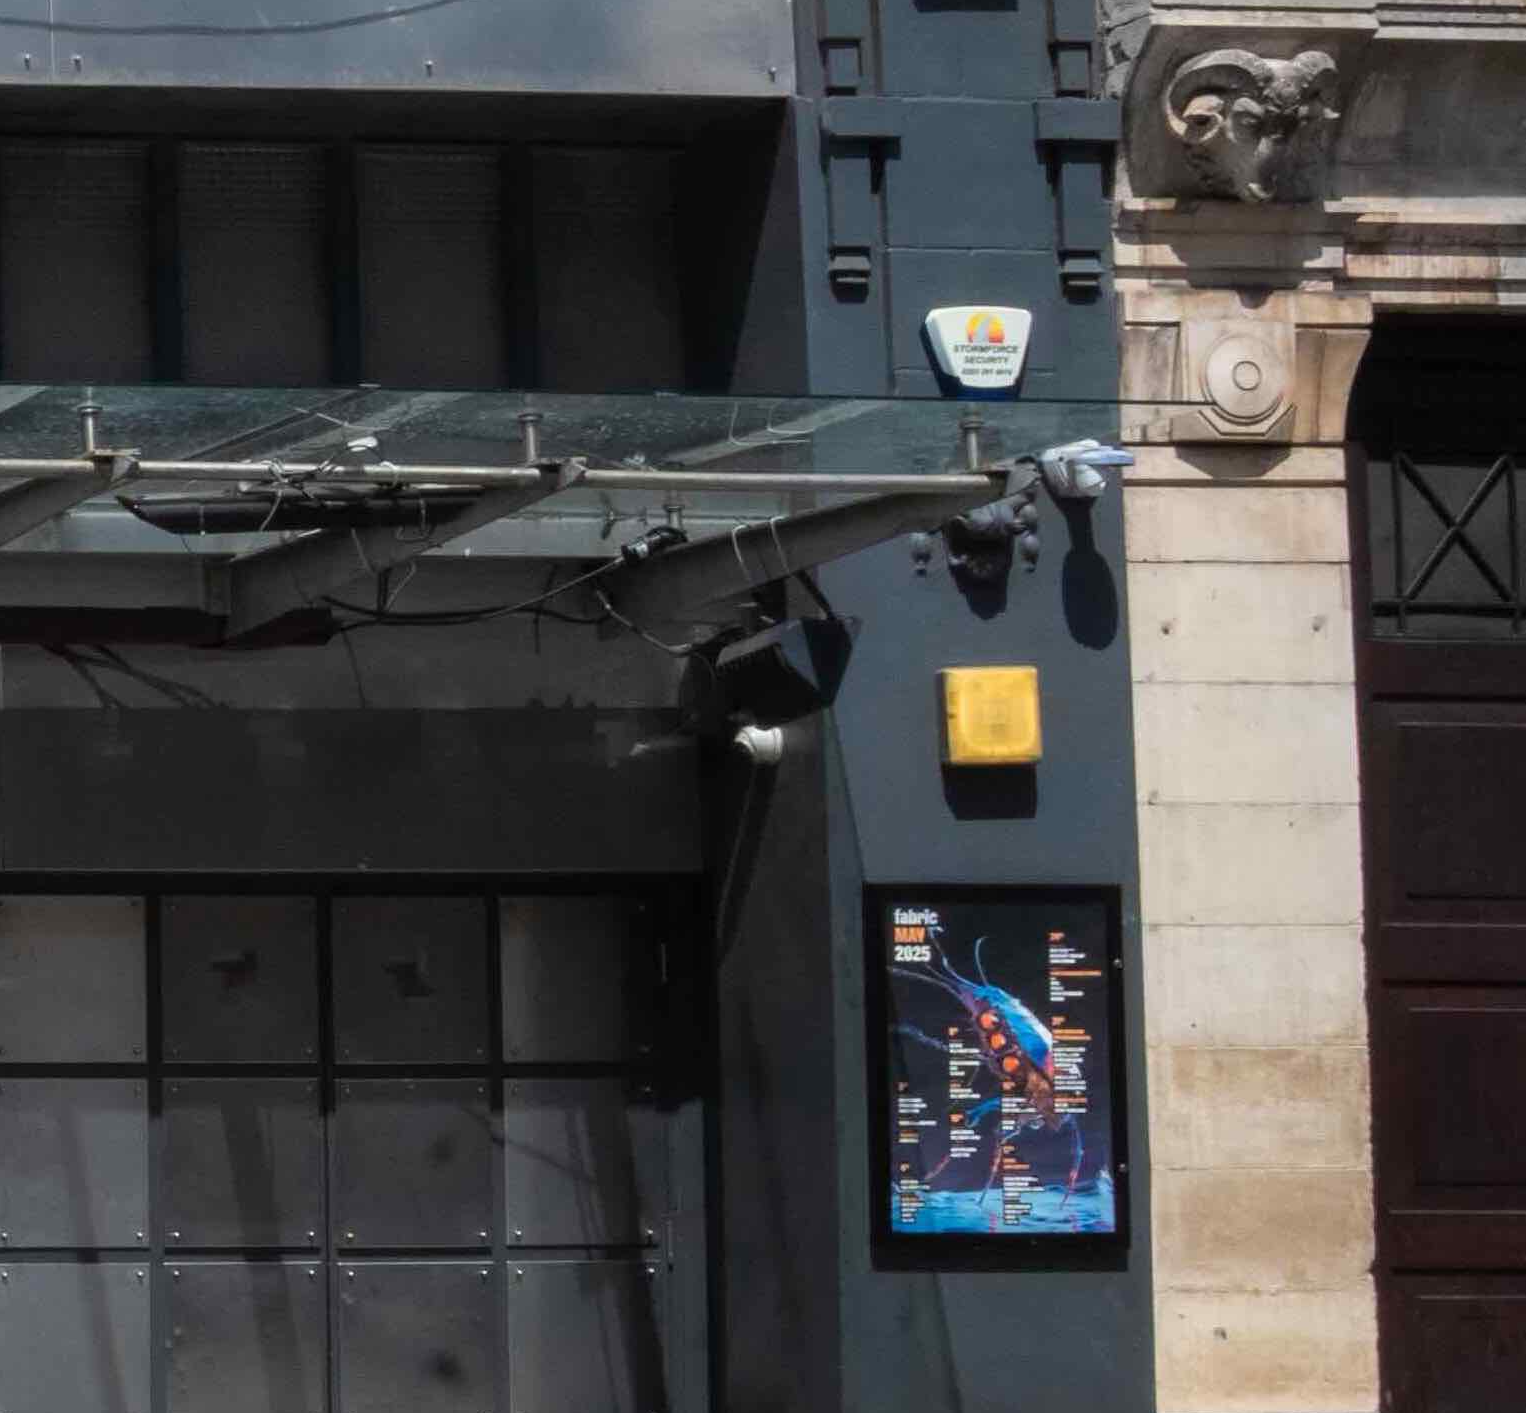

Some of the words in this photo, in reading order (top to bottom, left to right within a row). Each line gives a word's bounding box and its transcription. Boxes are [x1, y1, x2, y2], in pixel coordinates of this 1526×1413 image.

[963, 356, 1009, 364] SECURITY
[894, 908, 939, 925] fabric
[894, 927, 925, 943] MAY
[894, 945, 931, 962] 2025
